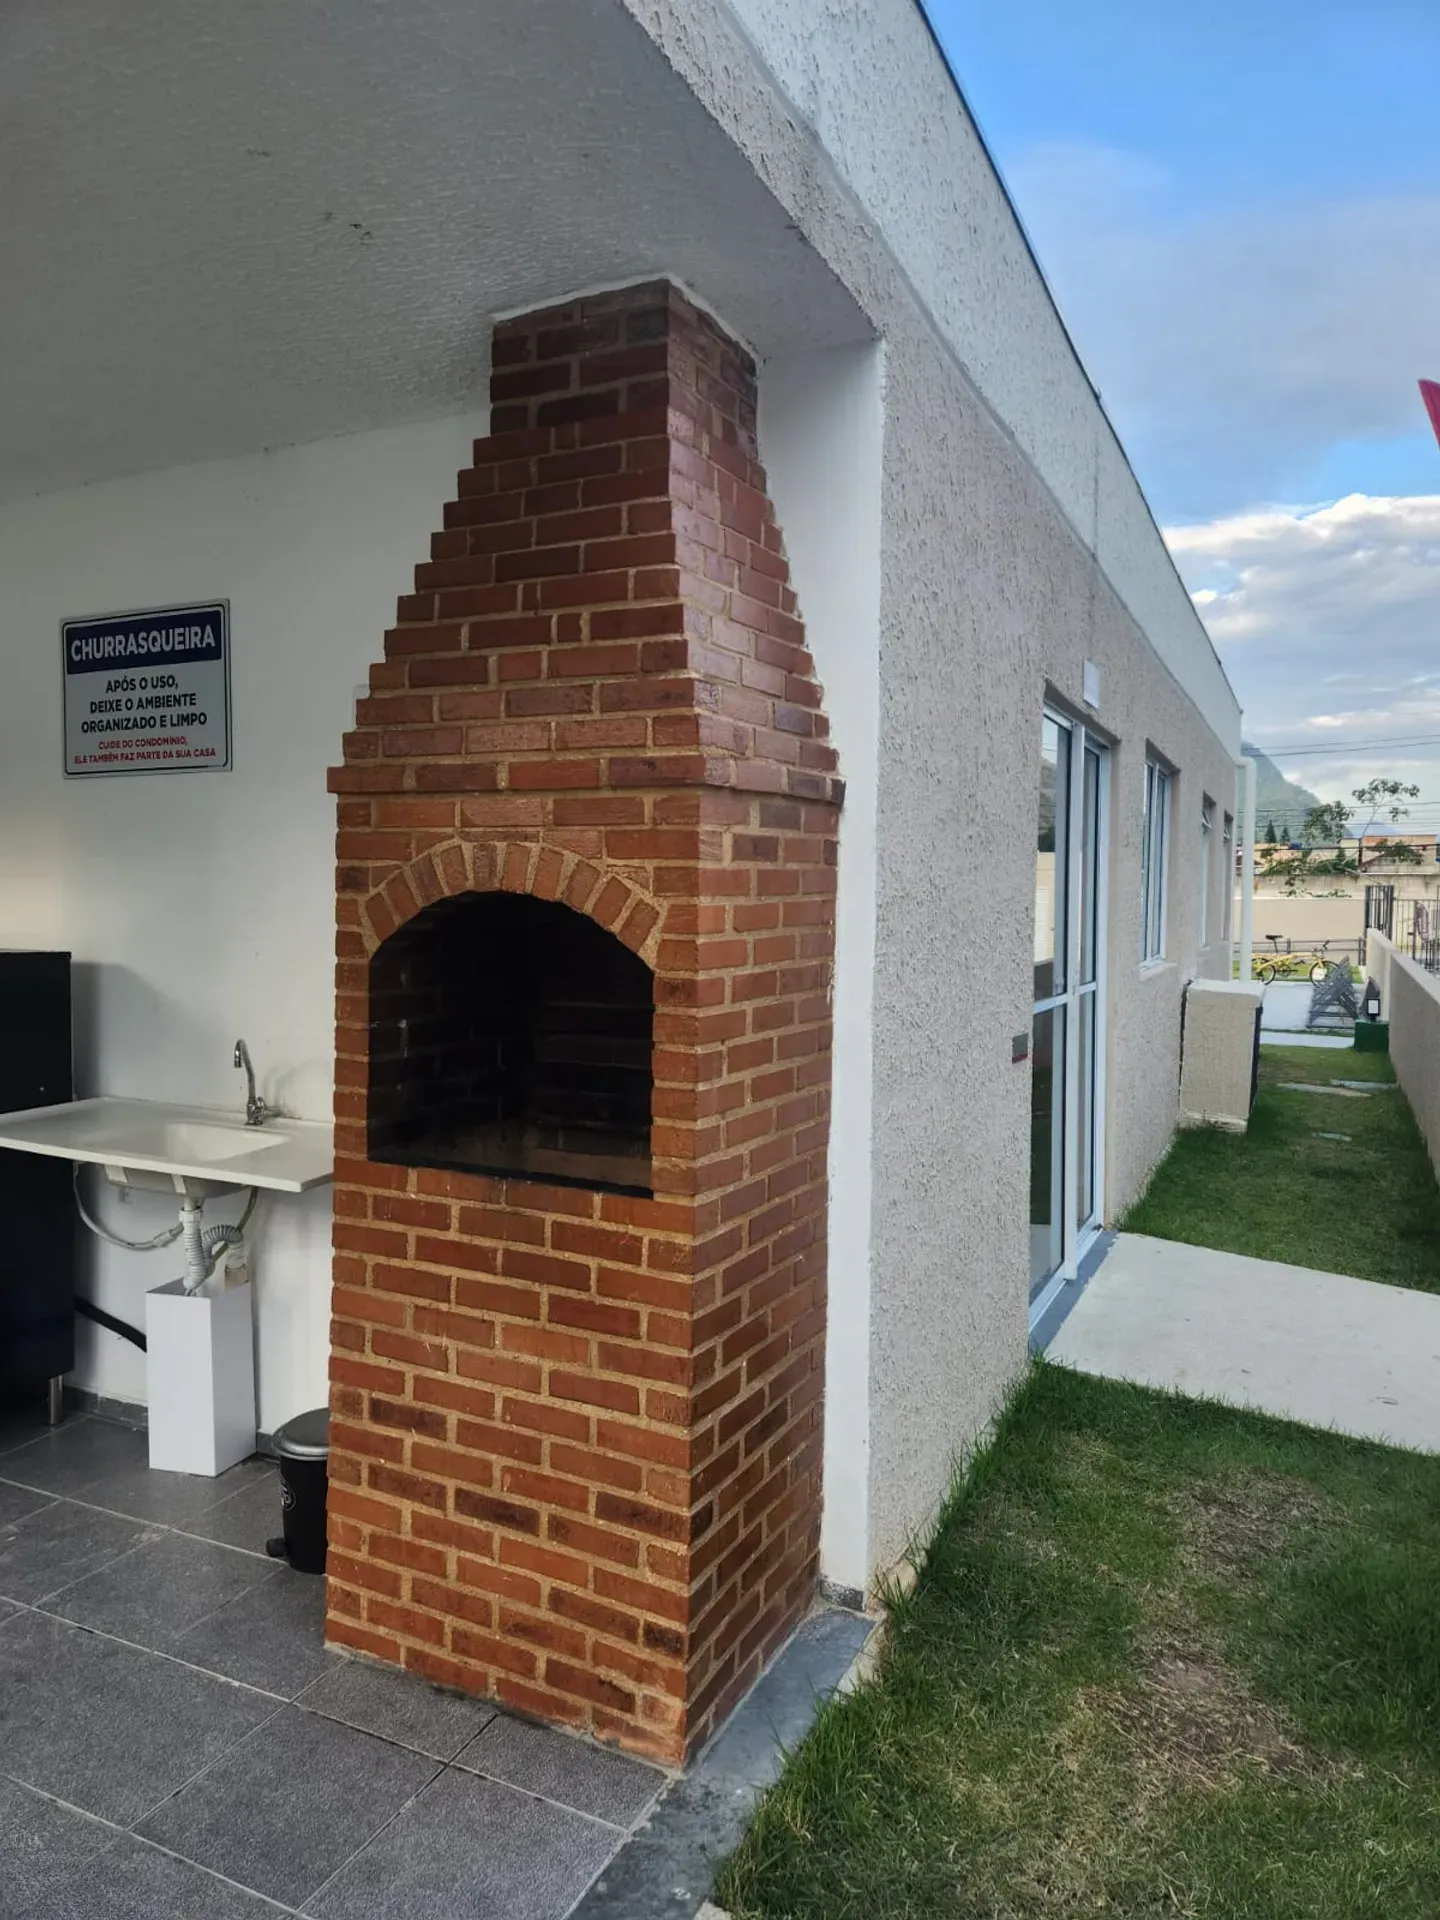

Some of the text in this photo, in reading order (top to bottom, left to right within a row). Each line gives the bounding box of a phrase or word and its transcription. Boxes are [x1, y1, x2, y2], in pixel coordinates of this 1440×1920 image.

[71, 625, 216, 662] CHURRASQUEIRA
[105, 675, 179, 693] APÓS O USO,
[90, 693, 197, 714] DEIXE O AMBIENTE
[81, 712, 208, 733] ORGANIZADO E LIMPO
[98, 740, 121, 750] CUIDE
[122, 739, 134, 749] DO
[74, 747, 217, 764] ELE TAMBÉM FAZ PARTE DA SUA CASA
